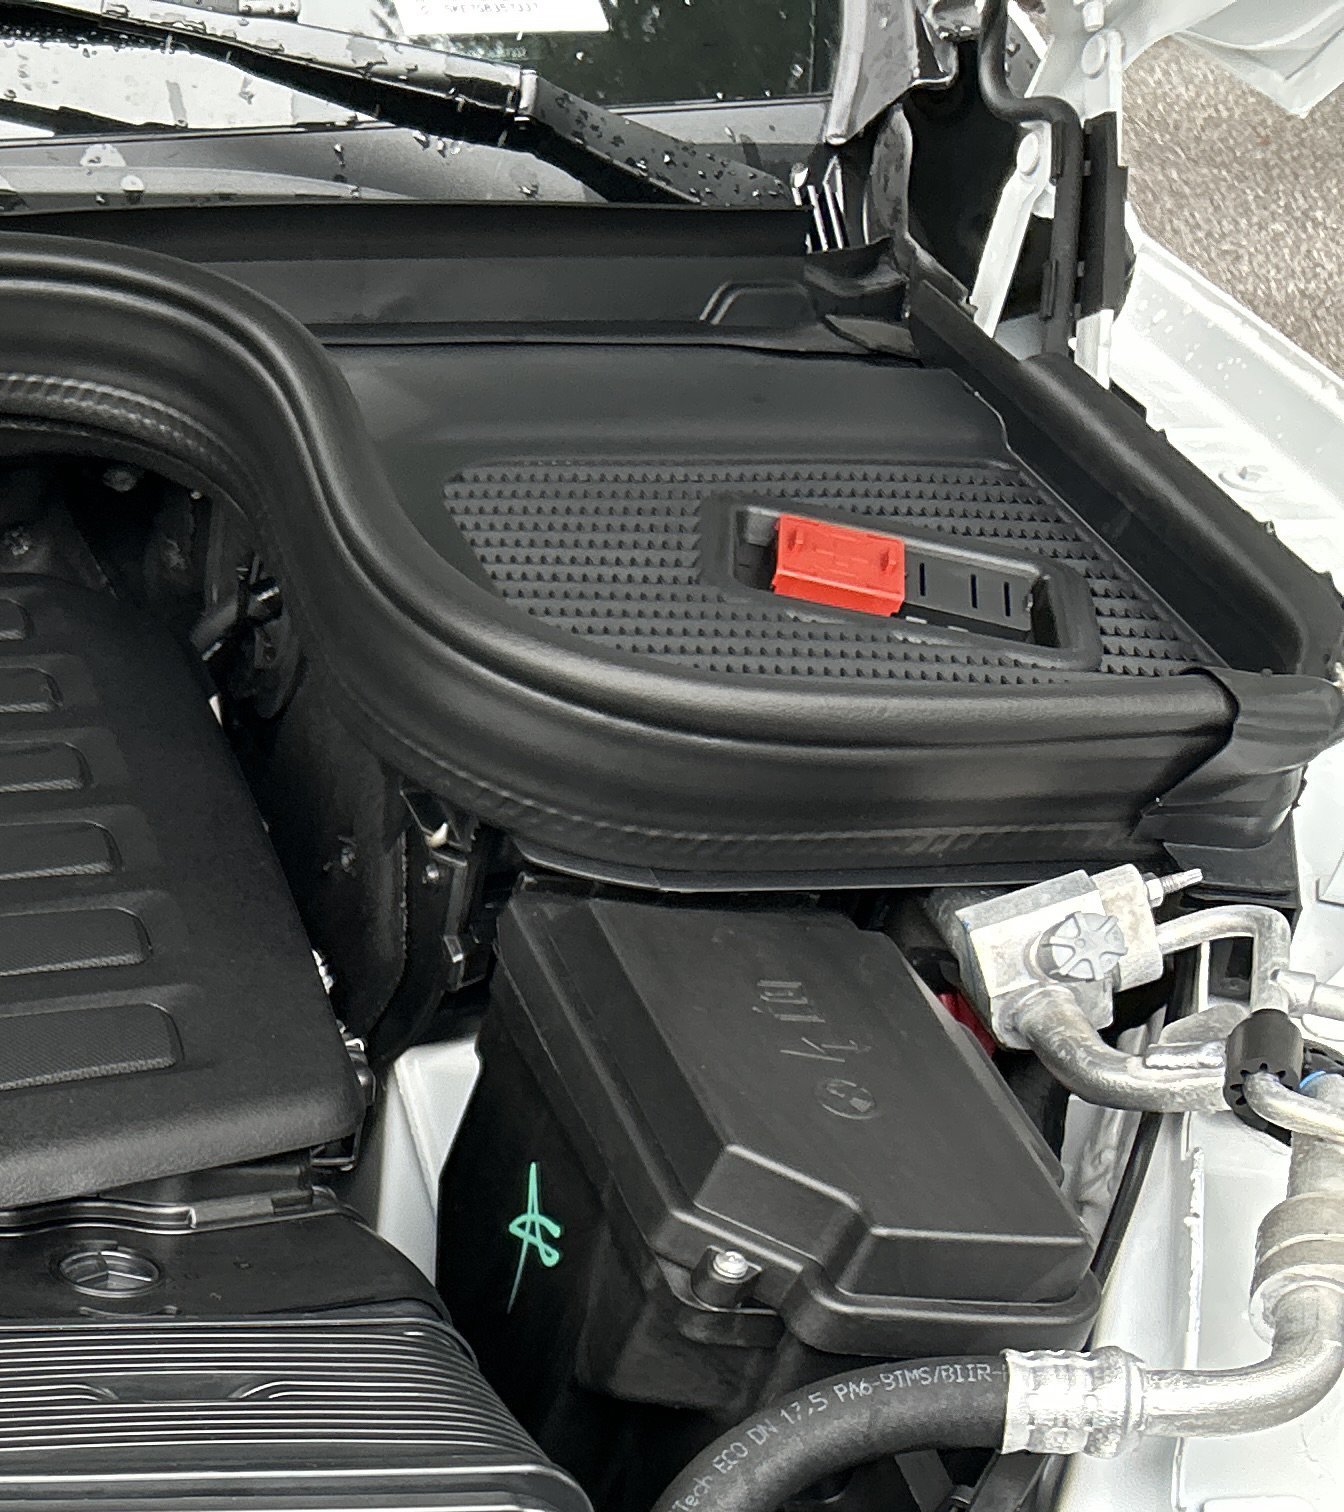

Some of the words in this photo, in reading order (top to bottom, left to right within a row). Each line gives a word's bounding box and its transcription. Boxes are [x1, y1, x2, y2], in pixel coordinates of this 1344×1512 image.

[712, 1441, 749, 1474] ECO
[746, 1418, 779, 1446] DN
[779, 1391, 829, 1425] 17,5
